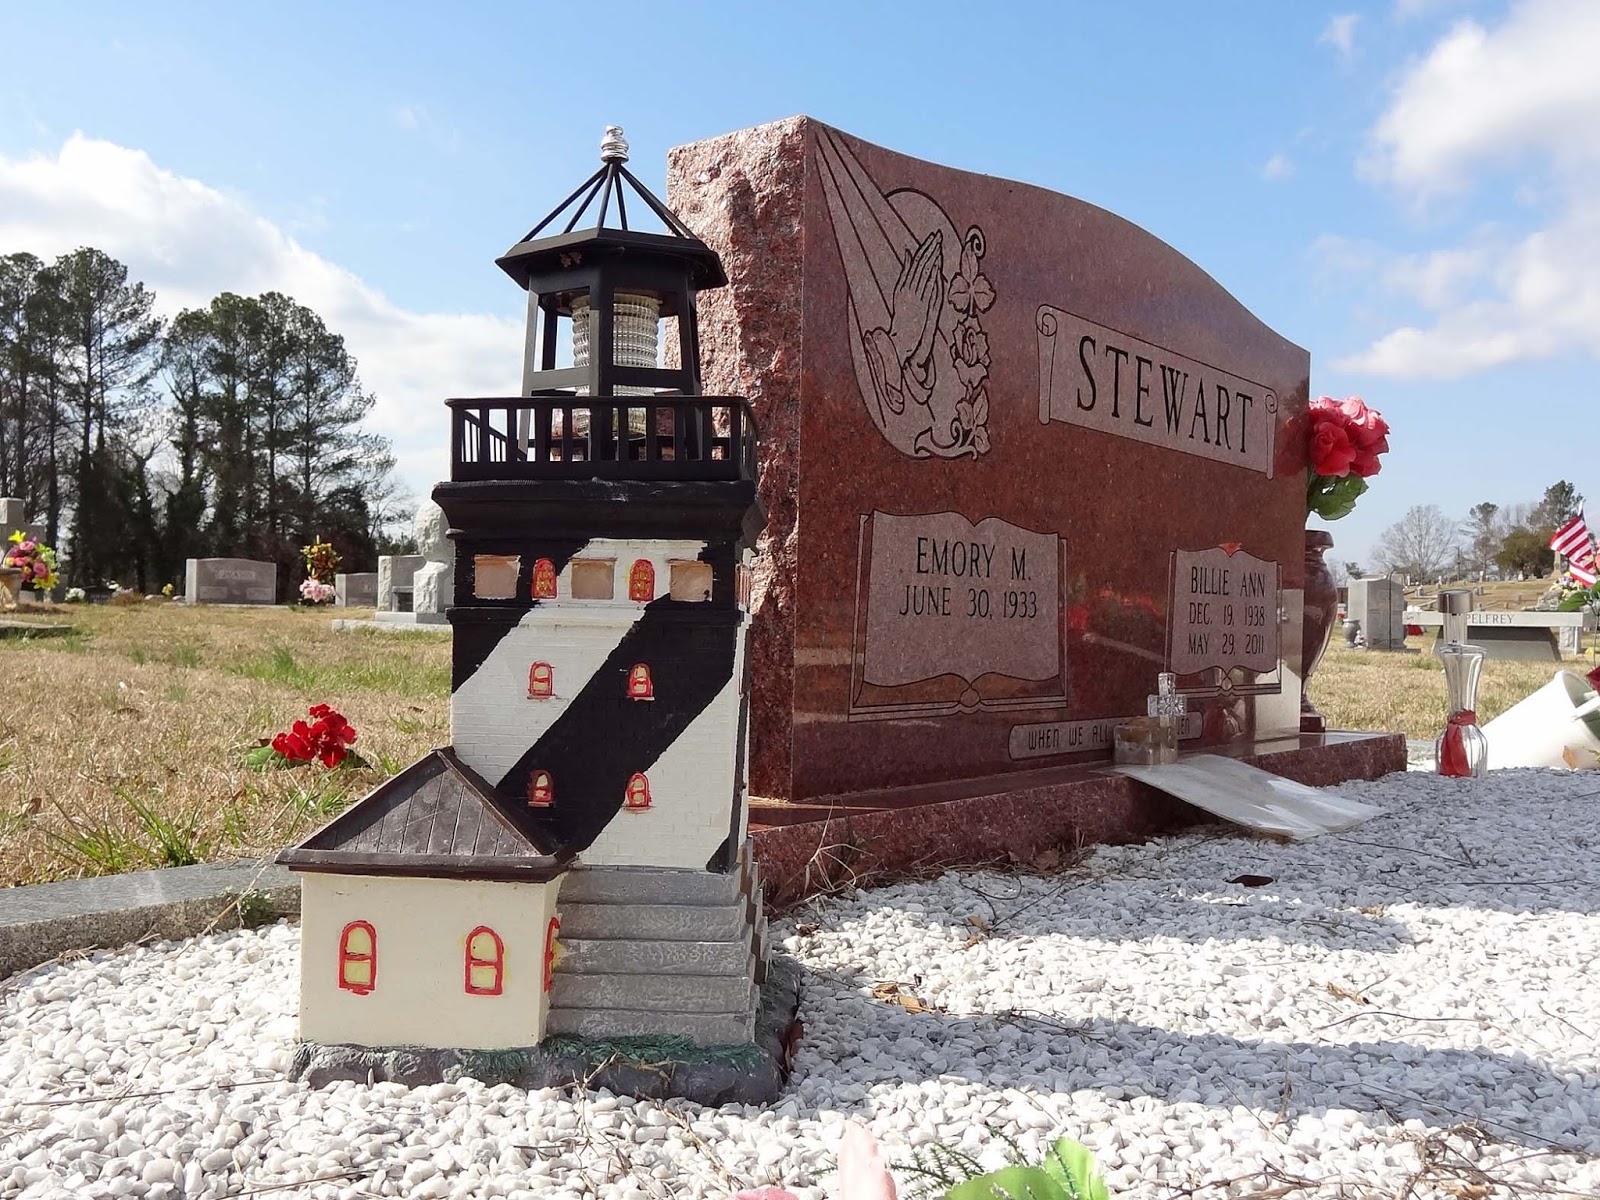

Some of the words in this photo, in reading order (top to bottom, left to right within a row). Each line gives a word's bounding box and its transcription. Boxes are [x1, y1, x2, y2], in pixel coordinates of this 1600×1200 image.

[1076, 335, 1253, 453] STEWART
[916, 536, 996, 578] EMORY
[1011, 546, 1032, 581] M.
[1191, 566, 1229, 595] BILLIE
[1239, 572, 1266, 598] ANN
[899, 585, 951, 616] JUNE
[966, 588, 993, 620] 30,
[1003, 591, 1037, 618] 1933
[1189, 602, 1213, 625] DEC.
[1244, 605, 1266, 627] 1938
[1466, 613, 1514, 624] PELFREY
[1188, 633, 1210, 655] MAY
[1245, 634, 1265, 655] 2011
[1028, 729, 1060, 751] WHEN
[1068, 726, 1084, 746] WE
[1092, 724, 1109, 743] ALL
